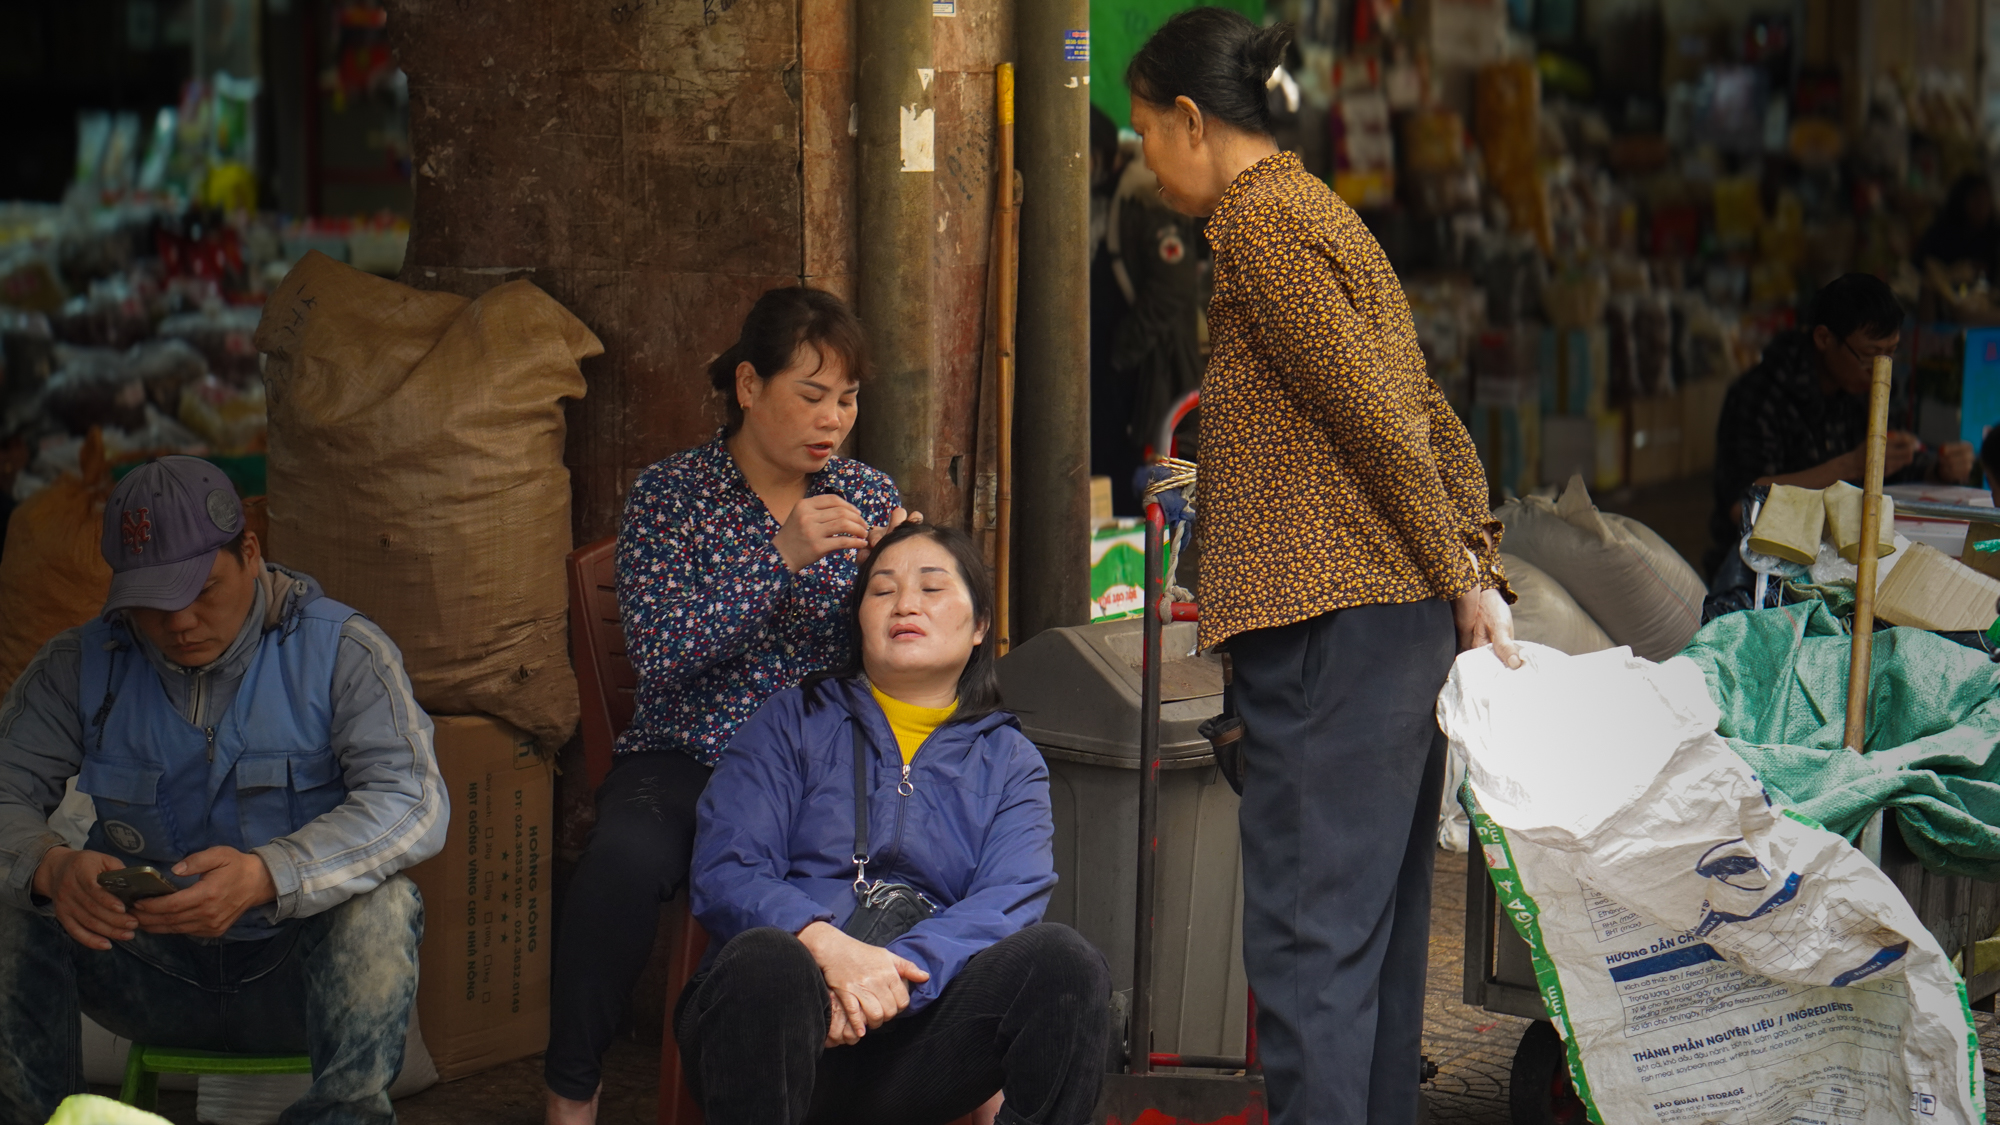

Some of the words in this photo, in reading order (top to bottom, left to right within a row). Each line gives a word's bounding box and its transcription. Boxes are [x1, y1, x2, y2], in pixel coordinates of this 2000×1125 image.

[466, 782, 478, 806] HẠT
[467, 810, 482, 856] GIỐNG
[528, 826, 541, 892] HOÀNG
[467, 859, 480, 896] VÀNG
[1497, 879, 1515, 893] 4
[466, 900, 476, 927] CHO
[527, 897, 540, 953] NÔNG
[466, 931, 479, 957] NHÀ
[1606, 948, 1648, 964] HƯỚNG
[1650, 937, 1676, 953] DẪN
[465, 961, 479, 1001] NÔNG
[1547, 985, 1562, 1014] mm
[1633, 1047, 1671, 1062] THÀNH
[1672, 1037, 1704, 1054] PHẦN
[1706, 1026, 1750, 1046] NGUYÊN
[1752, 1018, 1775, 1033] LIỆU
[1779, 1015, 1783, 1026] /
[1786, 1002, 1854, 1022] INGREDIENTS
[1706, 1087, 1745, 1100] STORAGE
